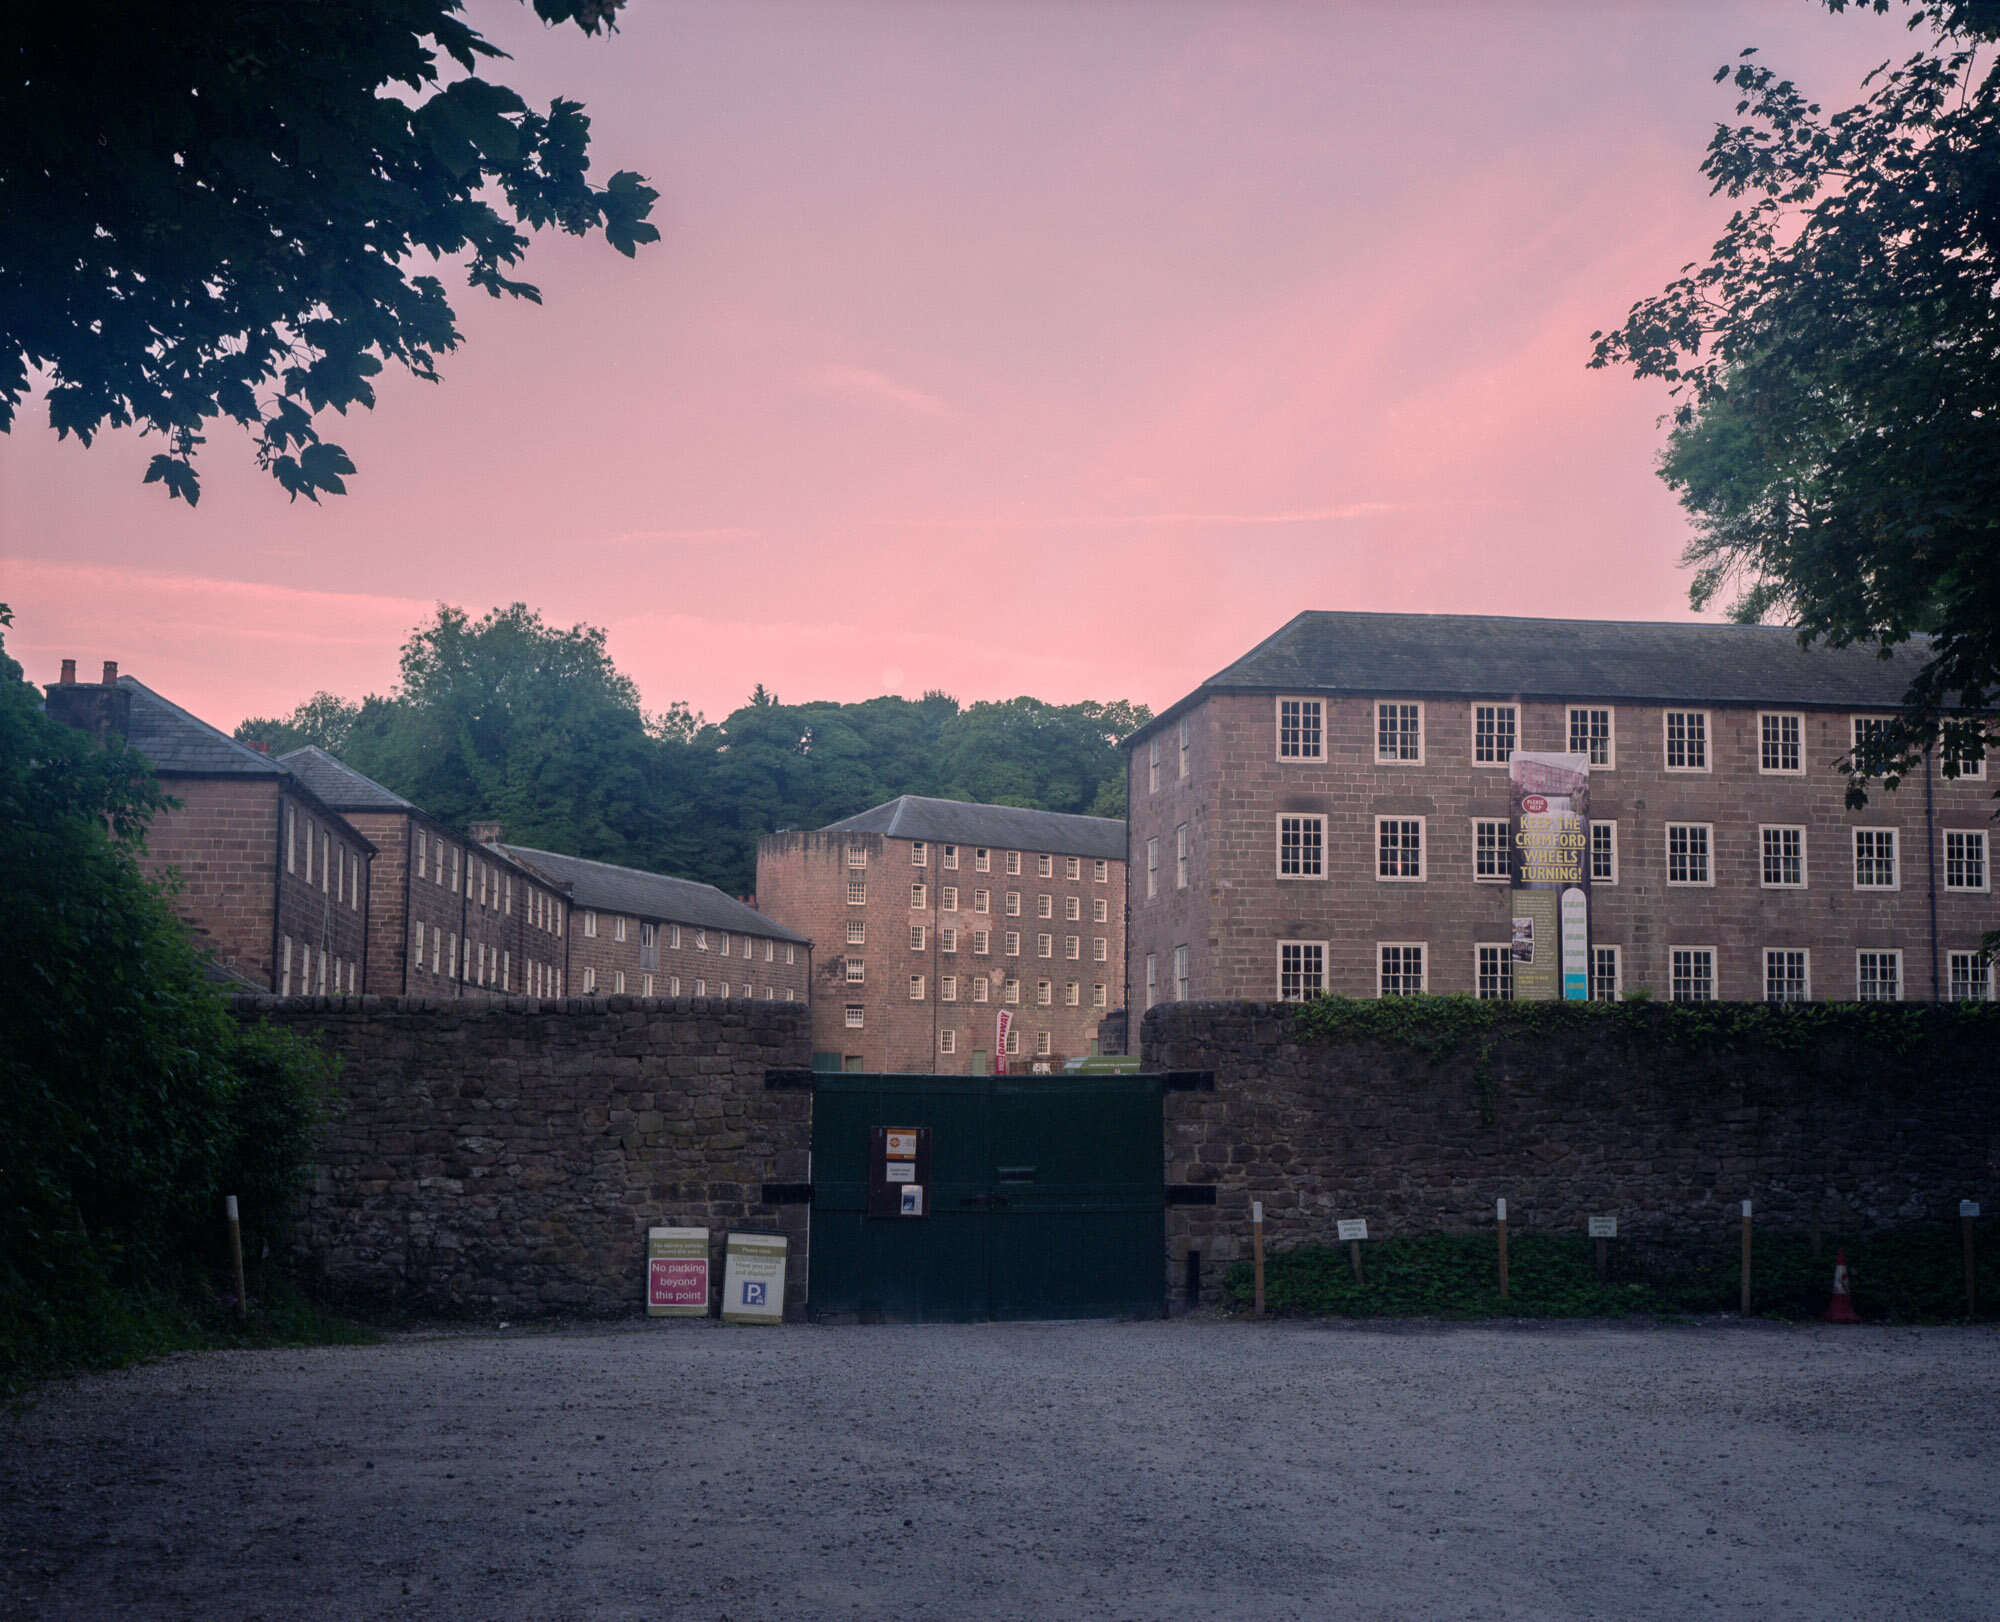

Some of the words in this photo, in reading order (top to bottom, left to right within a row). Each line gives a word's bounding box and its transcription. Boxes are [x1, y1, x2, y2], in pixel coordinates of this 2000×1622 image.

[1520, 816, 1553, 829] KEEP
[1557, 817, 1581, 830] THE
[1515, 833, 1586, 847] CROMFORD
[1523, 850, 1578, 863] WHEELS
[1520, 866, 1582, 880] TURNING!
[652, 1263, 666, 1272] No
[668, 1263, 705, 1274] parking
[660, 1277, 697, 1288] beyond
[655, 1290, 673, 1300] this
[675, 1290, 701, 1301] point
